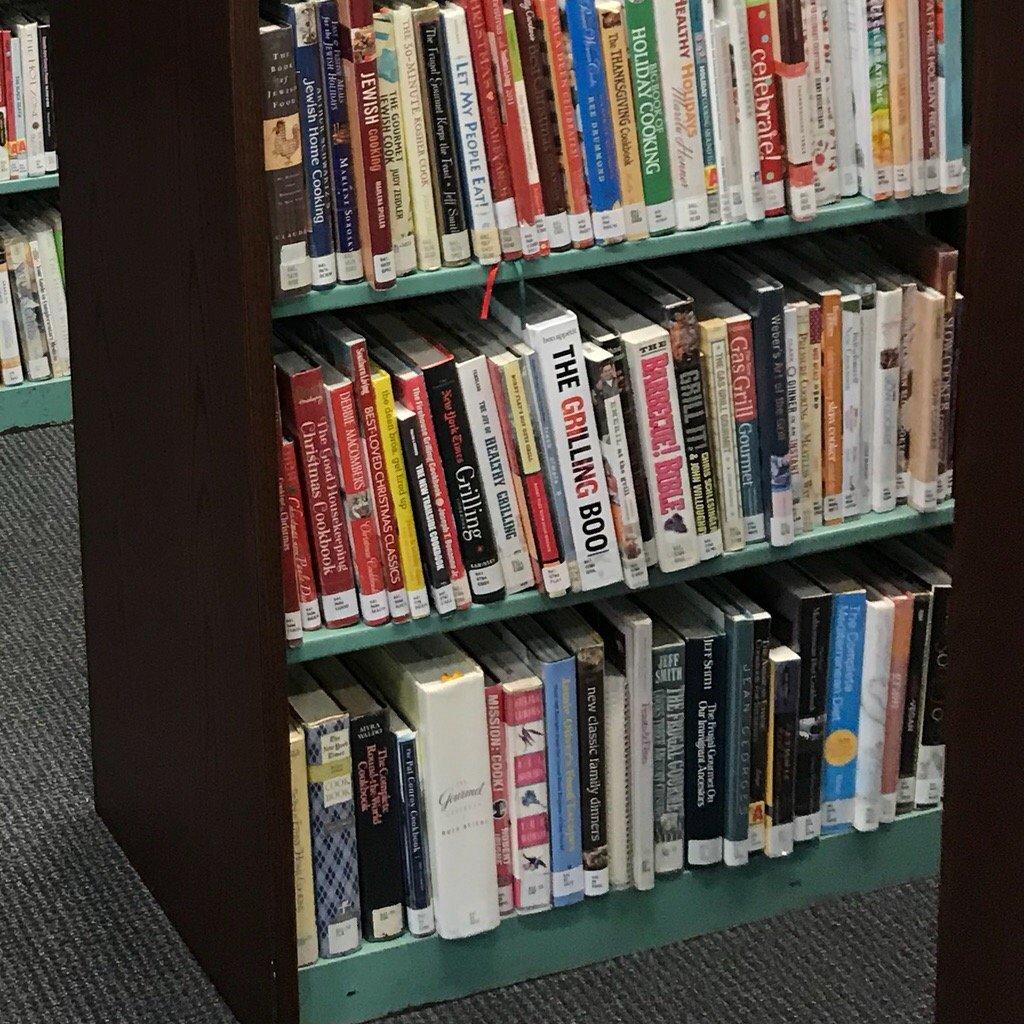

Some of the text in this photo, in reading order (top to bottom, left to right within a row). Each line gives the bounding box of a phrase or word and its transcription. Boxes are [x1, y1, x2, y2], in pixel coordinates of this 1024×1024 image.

[425, 28, 438, 44] The
[426, 47, 441, 76] Frugal
[360, 72, 383, 172] JEWISH cooking
[389, 112, 403, 163] GOURMET
[435, 117, 448, 141] Keeps
[455, 62, 488, 208] LET MY PEOPLE EAT!
[608, 33, 634, 166] The THANKSGIVING Cookbook
[630, 27, 662, 175] HOLIDAY COOKING
[681, 62, 698, 138] HOLIDAYS
[751, 48, 782, 161] celebrate!
[302, 78, 326, 224] Jewish Home Cooking
[439, 143, 451, 156] the
[389, 169, 405, 220] JUDY ZEIDLER
[639, 341, 667, 353] THE
[770, 314, 786, 359] Weber's
[641, 352, 686, 516] BARBECUE! BIBLE
[679, 369, 706, 425] GRILL
[729, 336, 755, 487] Gas Grill Gourmet
[415, 462, 426, 478] THE
[418, 479, 429, 496] NEW
[484, 436, 517, 540] HEALTHY GRILLING
[552, 344, 610, 558] THE GRILLING BOO
[300, 421, 334, 576] Christmas Cookbook
[315, 419, 349, 572] The Good Housekeeping
[364, 406, 401, 584] BEST-LOVED CHRISTMAS CLASSICS
[454, 465, 484, 542] Grilling
[486, 694, 501, 752] MISSION:
[406, 760, 416, 774] Pat
[586, 686, 603, 842] new classic family dinners
